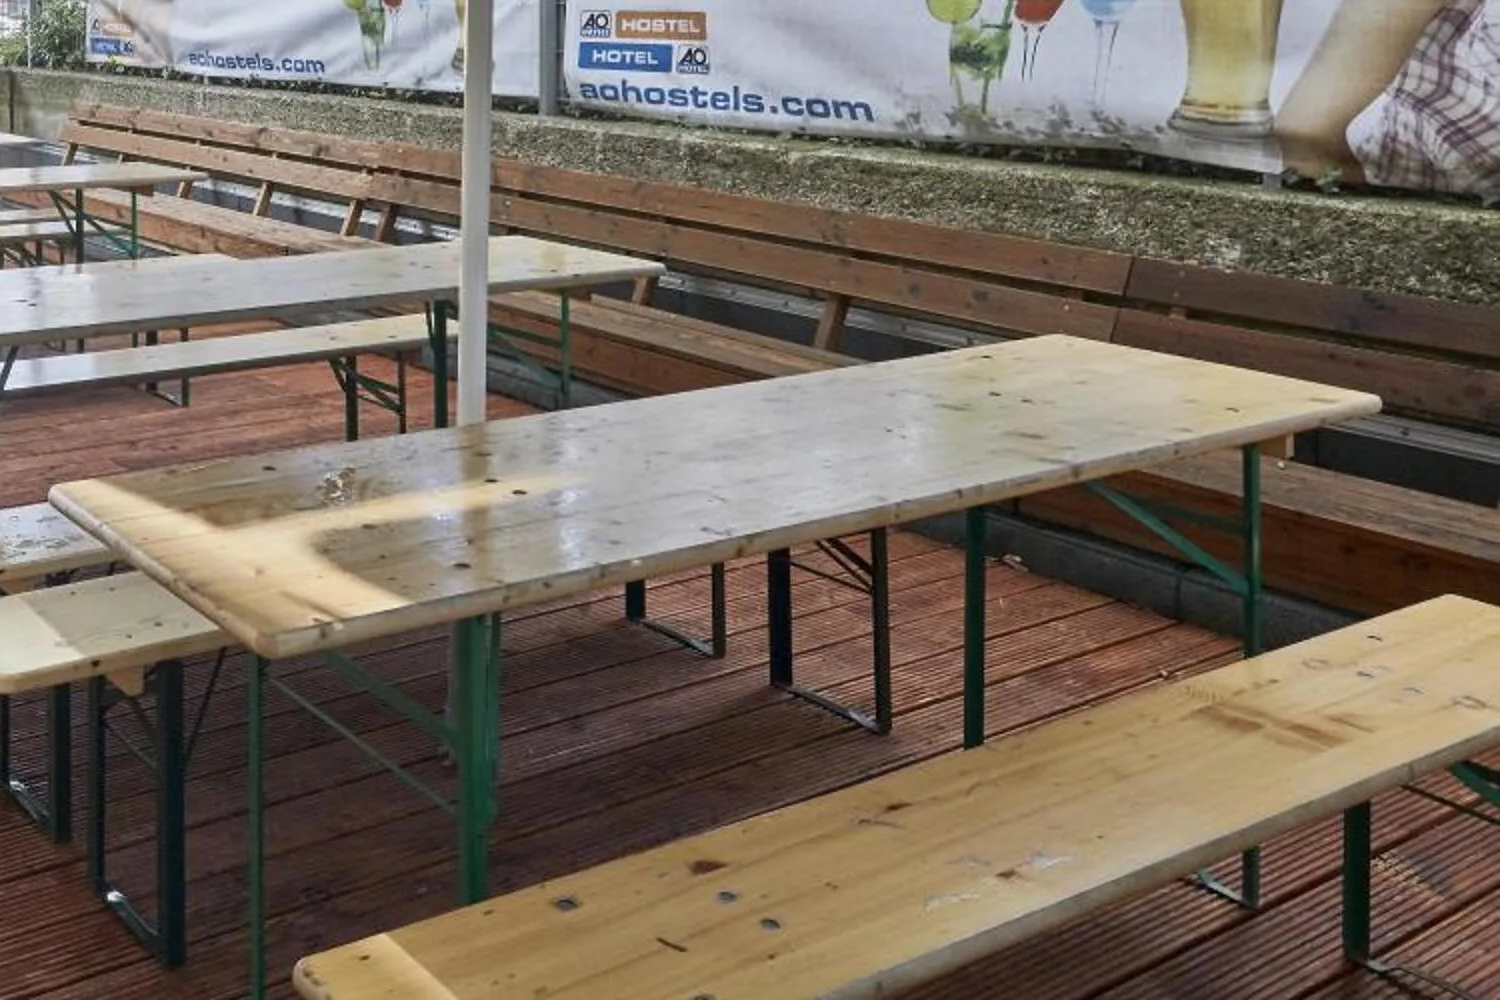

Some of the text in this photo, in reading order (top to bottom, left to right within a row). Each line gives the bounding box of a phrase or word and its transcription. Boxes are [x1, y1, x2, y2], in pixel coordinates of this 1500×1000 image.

[583, 13, 609, 29] AO
[621, 18, 700, 33] HOSTEL
[592, 49, 659, 65] HOTEL
[680, 48, 707, 65] AO
[579, 79, 876, 122] aohostels.com
